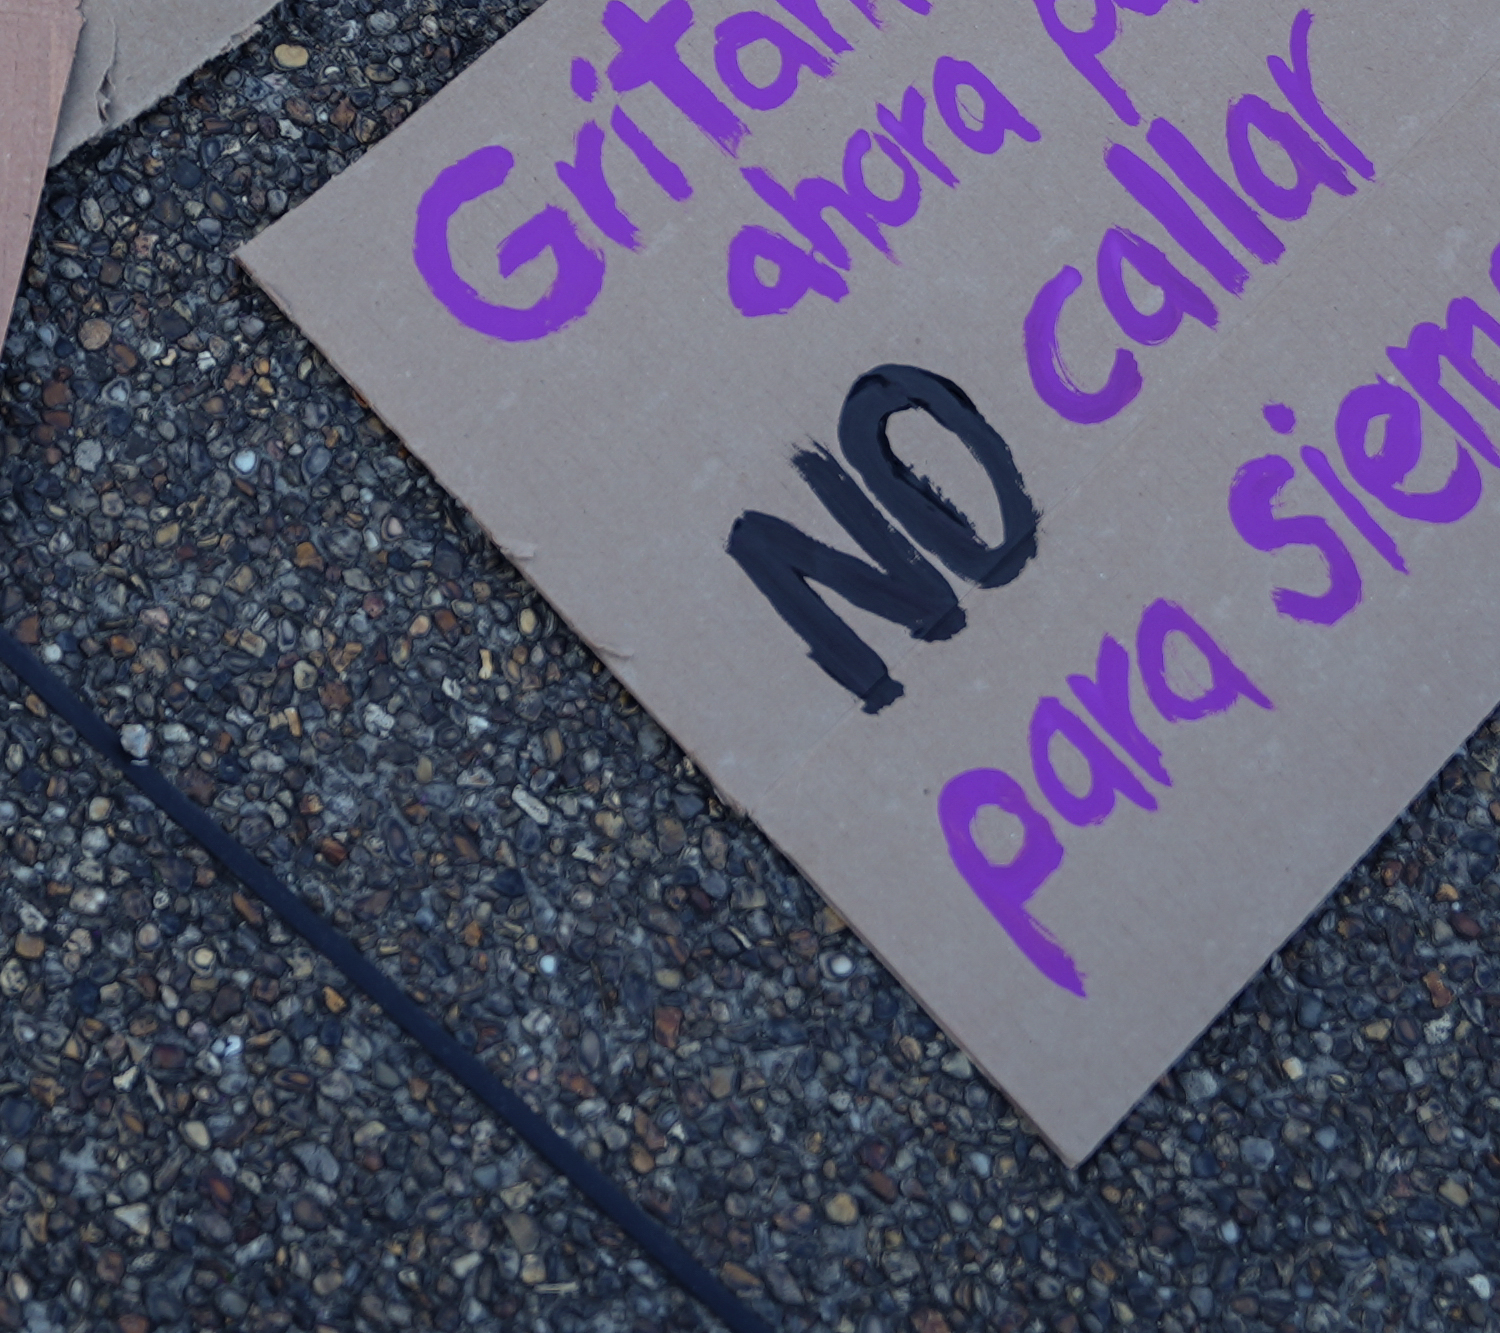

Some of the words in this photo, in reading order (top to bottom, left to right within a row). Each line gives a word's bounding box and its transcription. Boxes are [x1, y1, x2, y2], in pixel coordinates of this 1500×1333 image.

[724, 362, 1044, 717] NO
[1023, 8, 1377, 427] callar
[726, 52, 1041, 320] ahora
[937, 596, 1277, 1000] para
